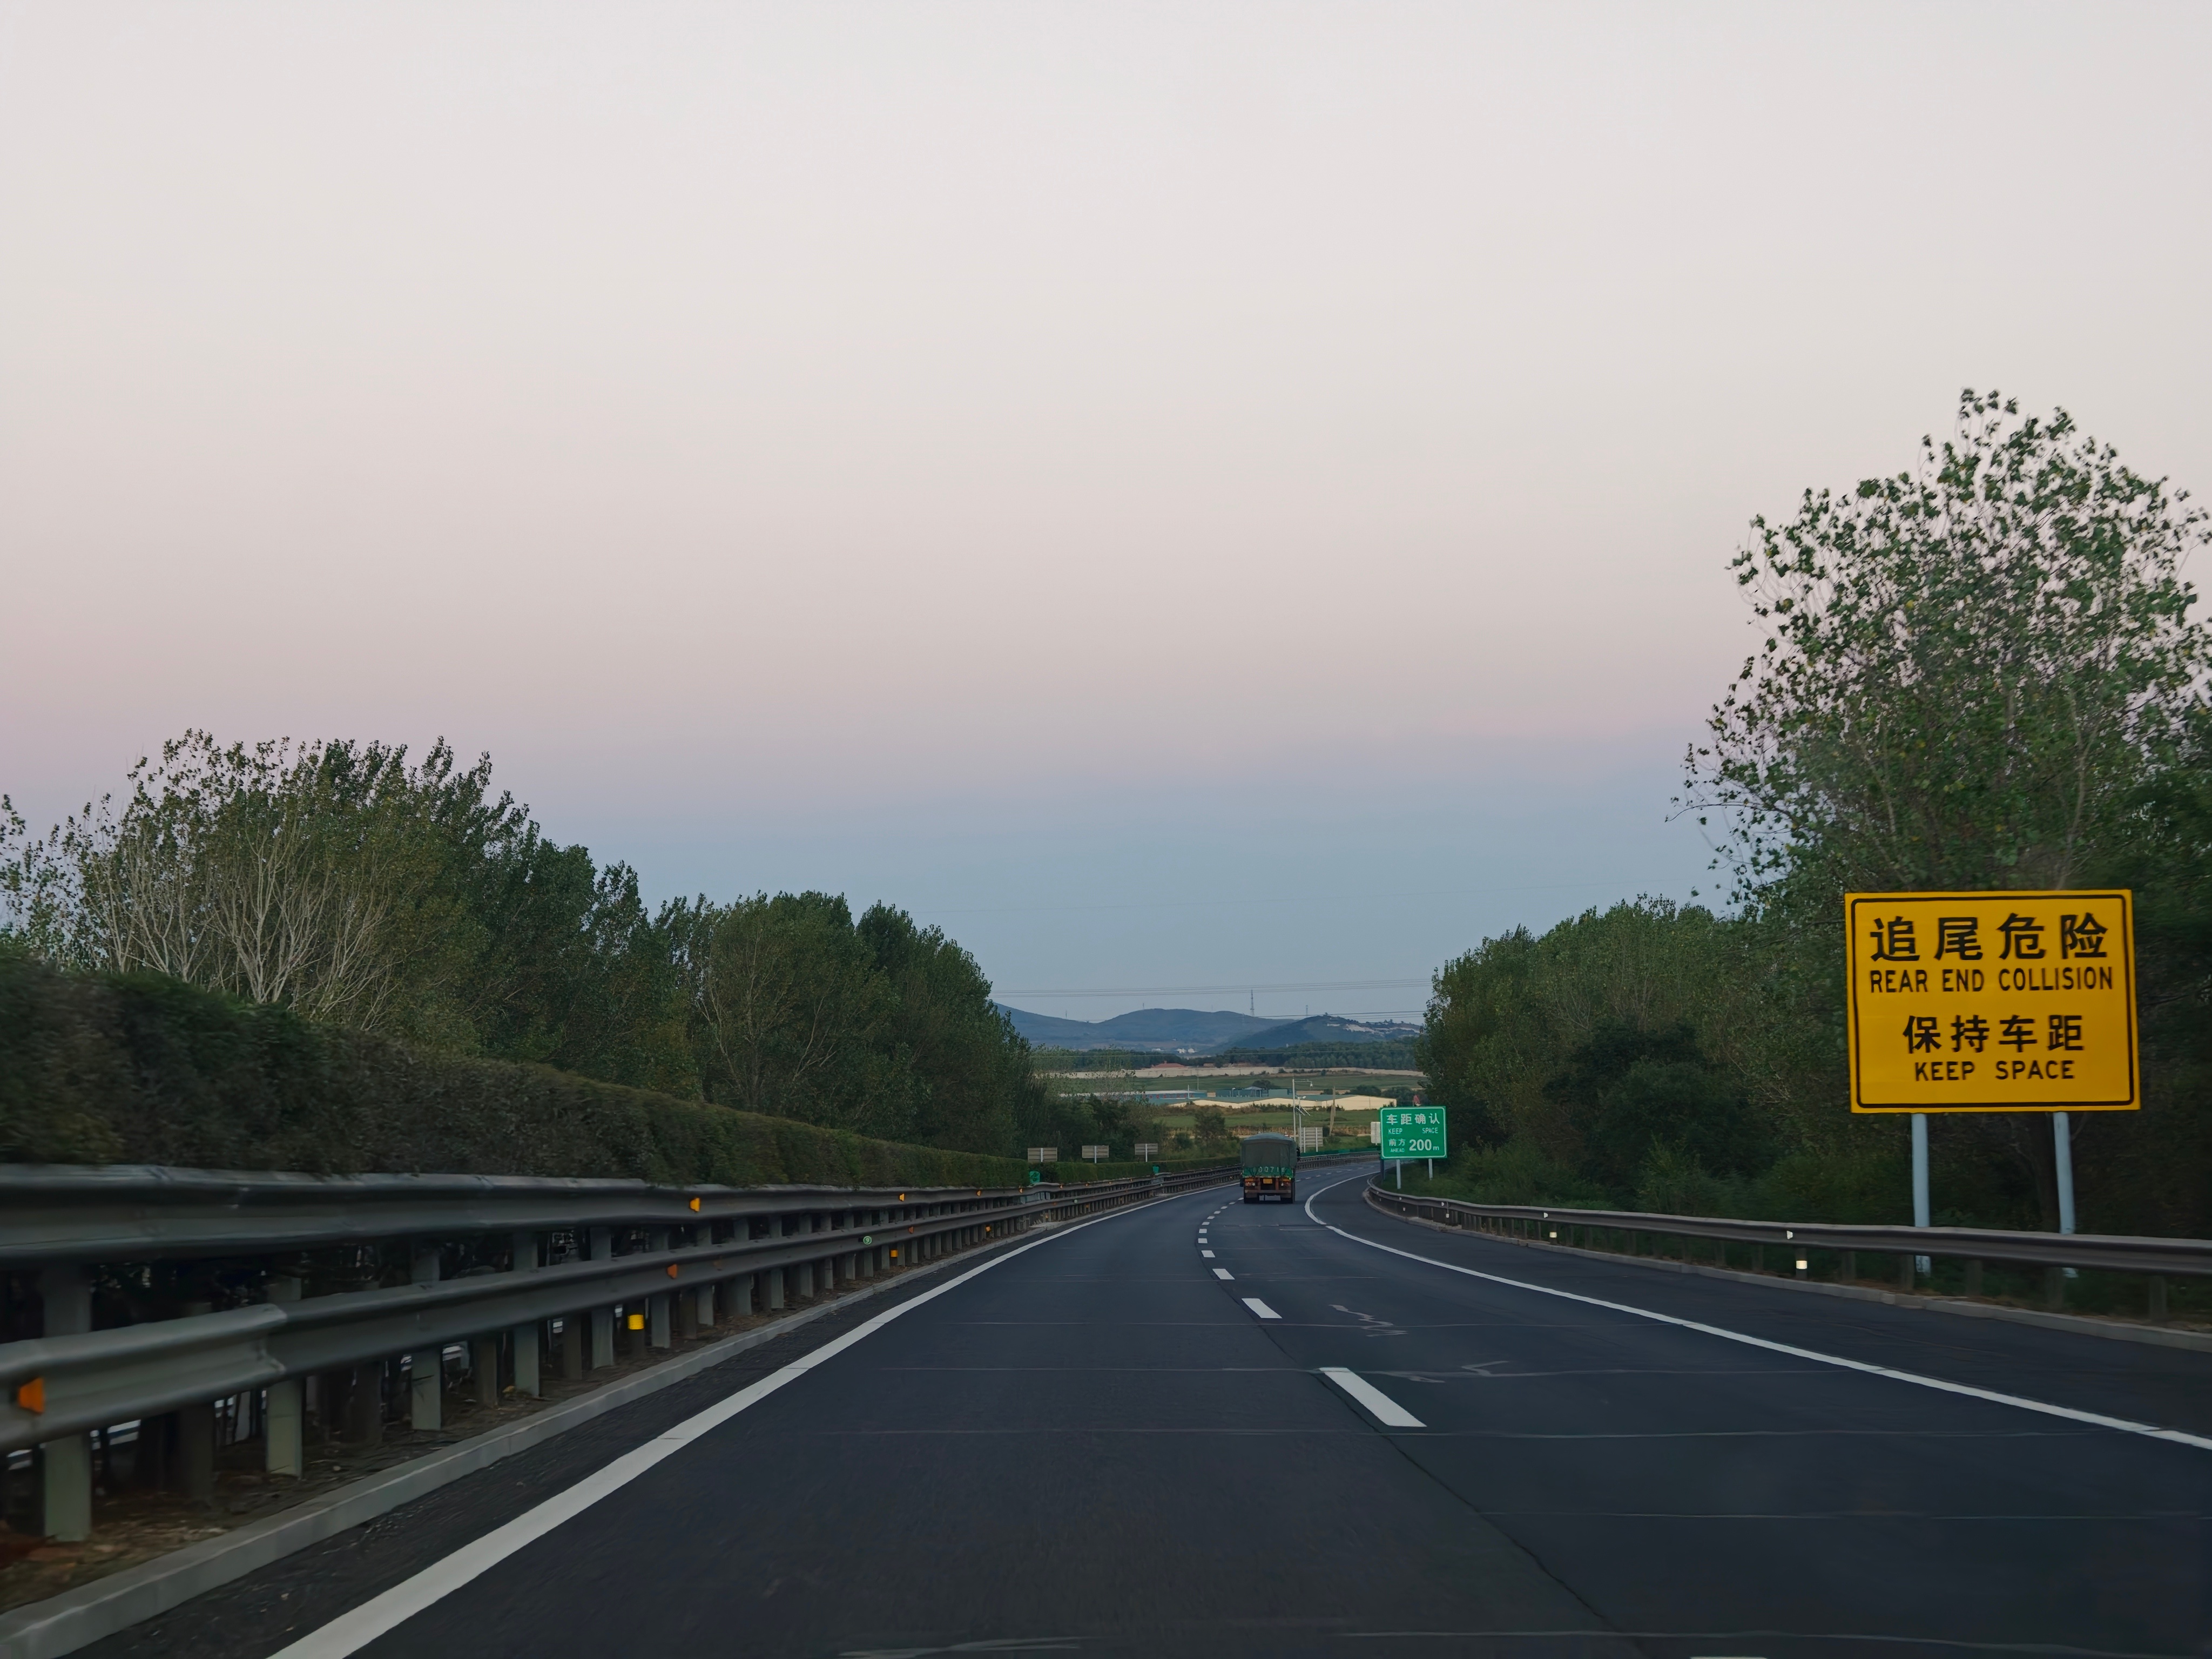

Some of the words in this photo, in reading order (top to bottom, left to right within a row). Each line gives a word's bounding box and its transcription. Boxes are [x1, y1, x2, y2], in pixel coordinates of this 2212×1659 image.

[1870, 912, 2108, 962] 追尾危险
[1870, 969, 1928, 993] REAR
[1942, 968, 1985, 992] END
[1999, 966, 2113, 991] COLLISION
[1902, 1014, 2085, 1054] 保持车距
[1914, 1061, 1975, 1082] KEEP
[1995, 1060, 2075, 1080] SPACE
[1386, 1113, 1440, 1125] 车距确认
[1388, 1138, 1406, 1147] 前方
